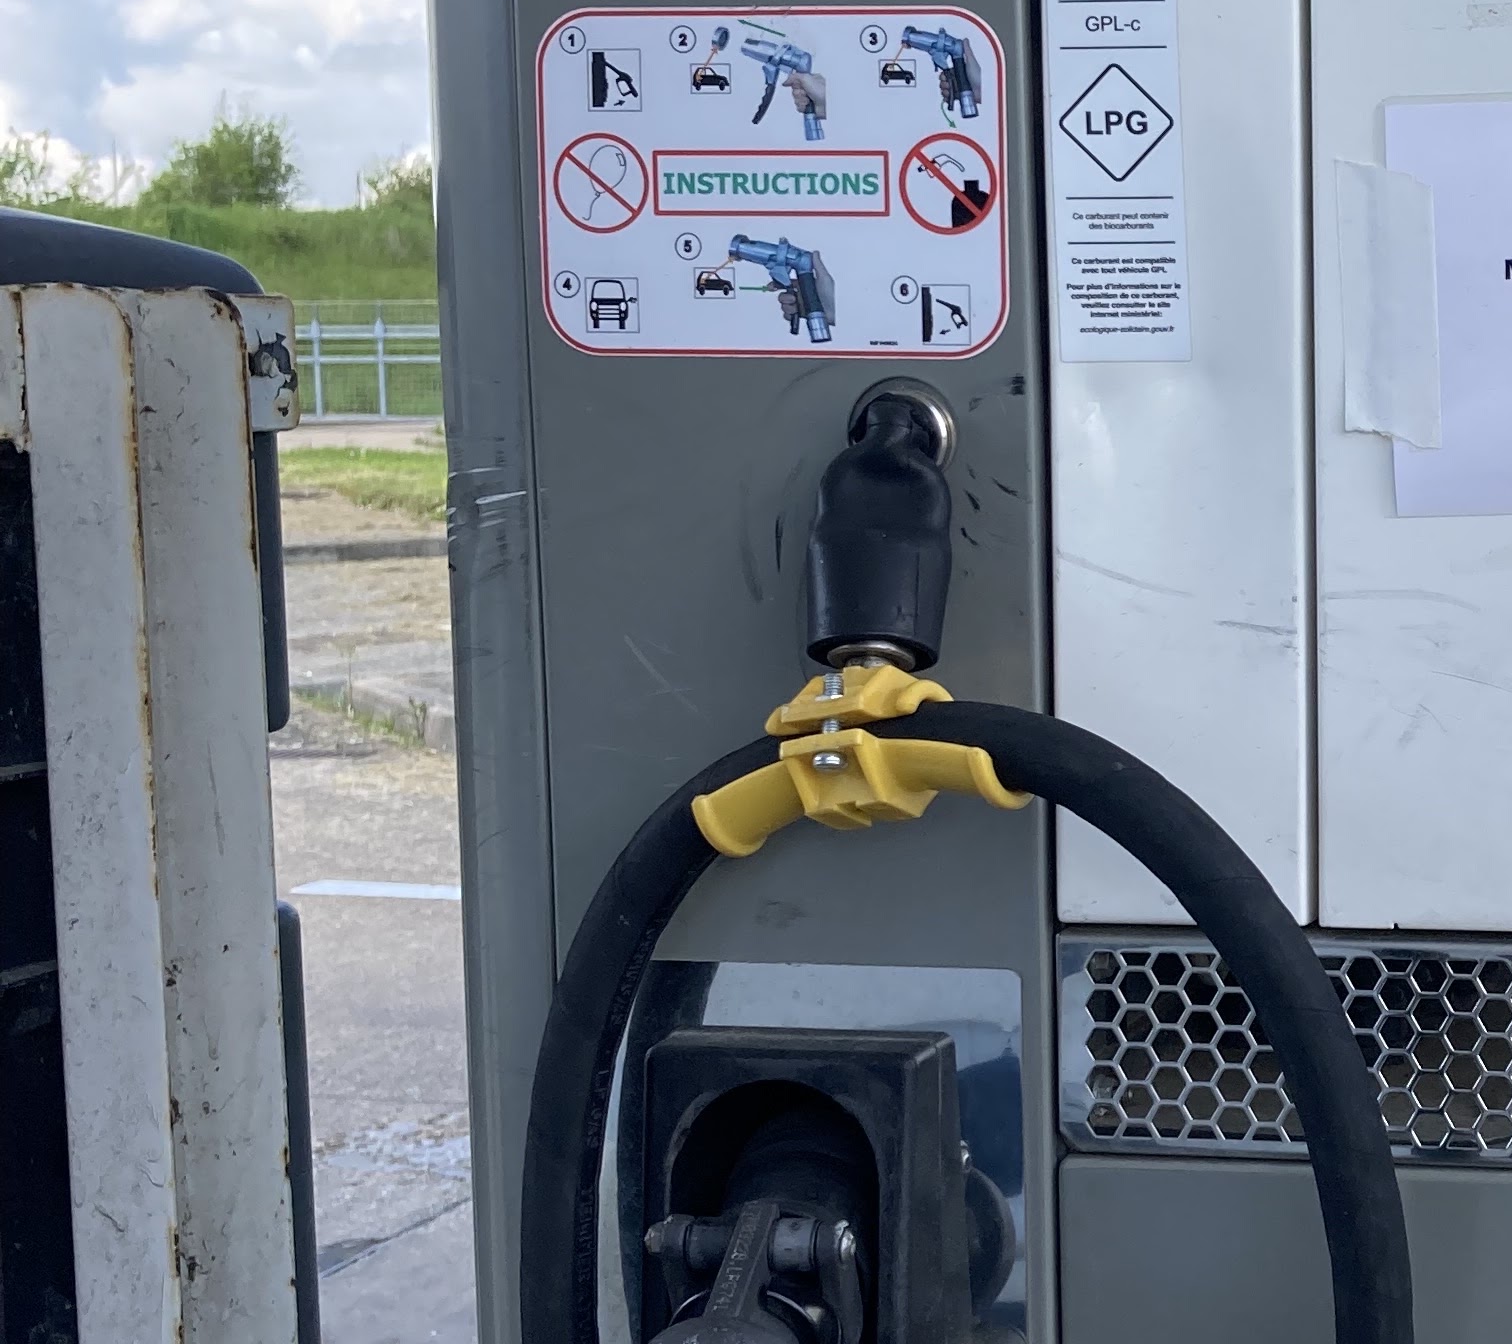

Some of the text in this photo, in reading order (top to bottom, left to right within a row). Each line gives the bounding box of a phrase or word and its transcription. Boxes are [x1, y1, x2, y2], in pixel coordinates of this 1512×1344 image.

[1085, 16, 1141, 32] GPL-c
[567, 33, 576, 46] 1
[678, 32, 689, 46] 2
[868, 32, 878, 45] 3
[1086, 111, 1148, 135] LPG
[664, 171, 879, 196] INSTRUCTIONS
[1085, 212, 1120, 220] carburant
[1122, 212, 1138, 221] peut
[1104, 222, 1154, 230] biocarburants
[682, 240, 693, 253] 5
[562, 277, 572, 291] 4
